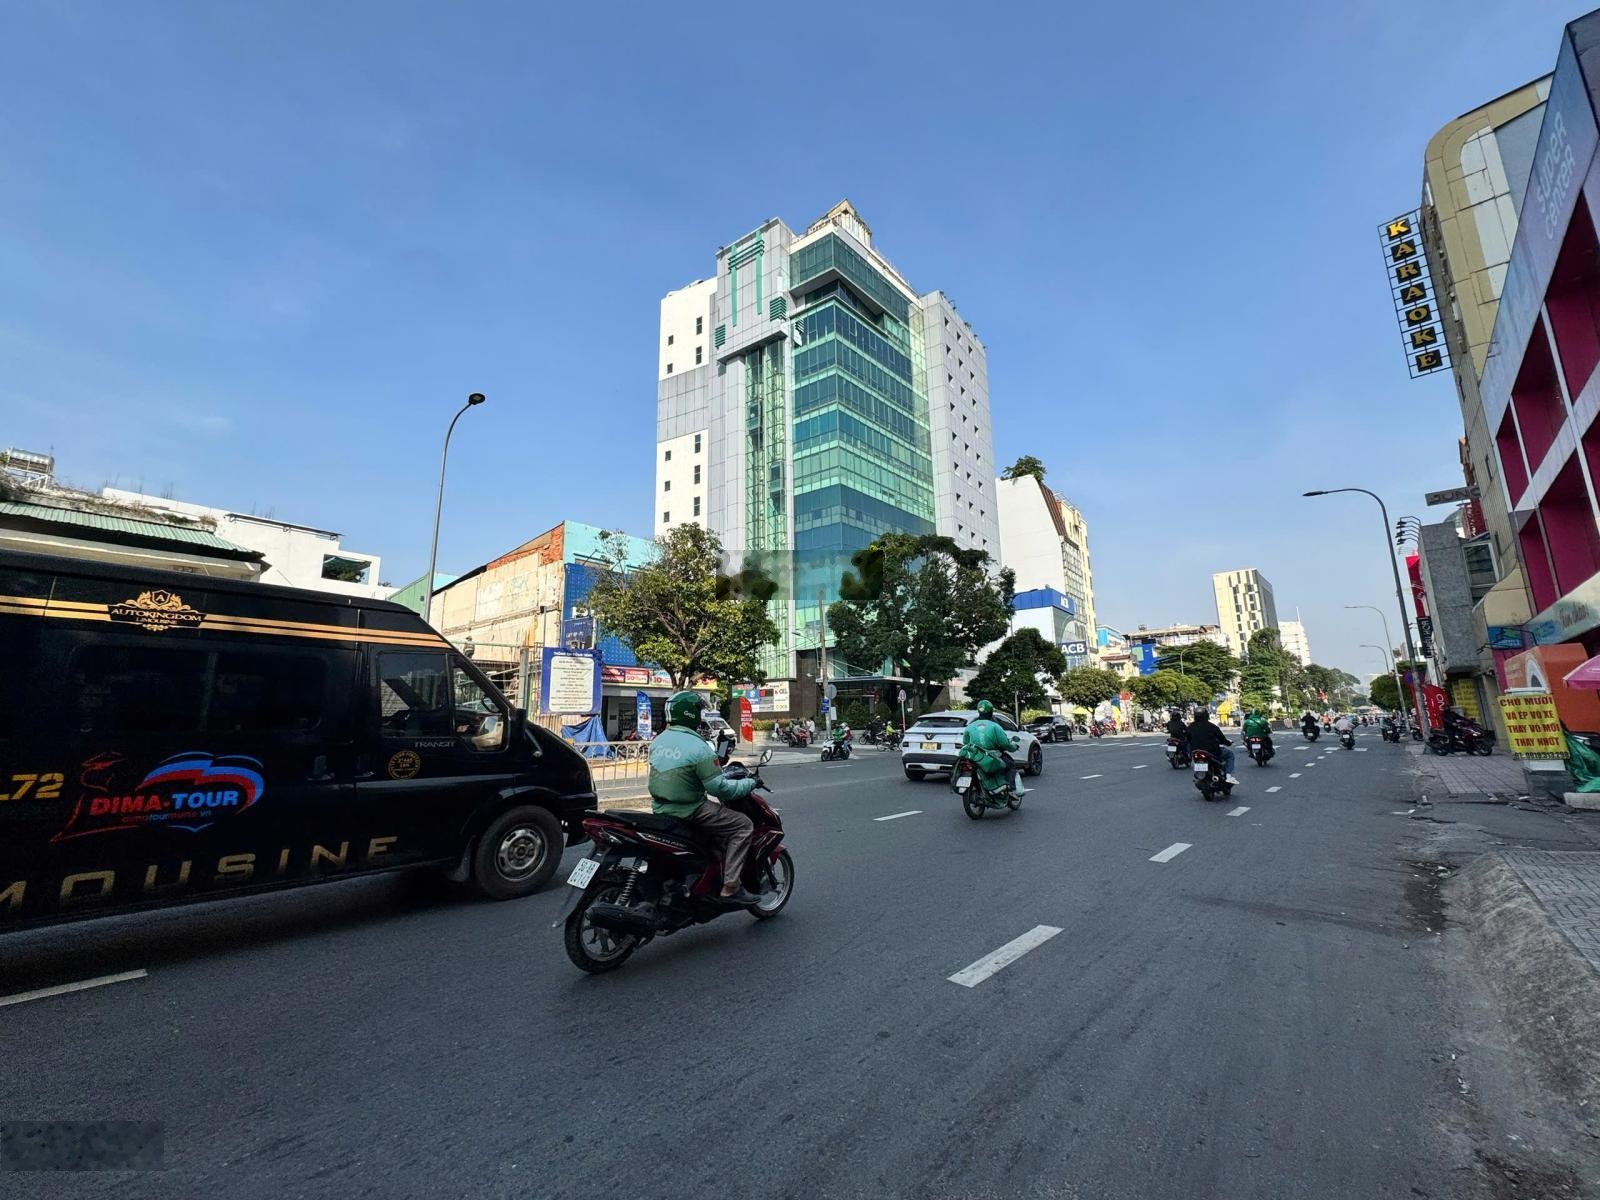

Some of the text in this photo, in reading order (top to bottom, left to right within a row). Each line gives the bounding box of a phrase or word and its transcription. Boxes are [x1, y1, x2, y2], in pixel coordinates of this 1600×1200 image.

[1388, 219, 1437, 369] KARAOKE
[156, 594, 165, 602] A
[111, 608, 202, 621] AUTOKINGDOM
[1060, 643, 1086, 655] ACB
[683, 710, 696, 719] Grab
[0, 772, 64, 801] 72
[90, 790, 240, 816] DIMA-TOUR
